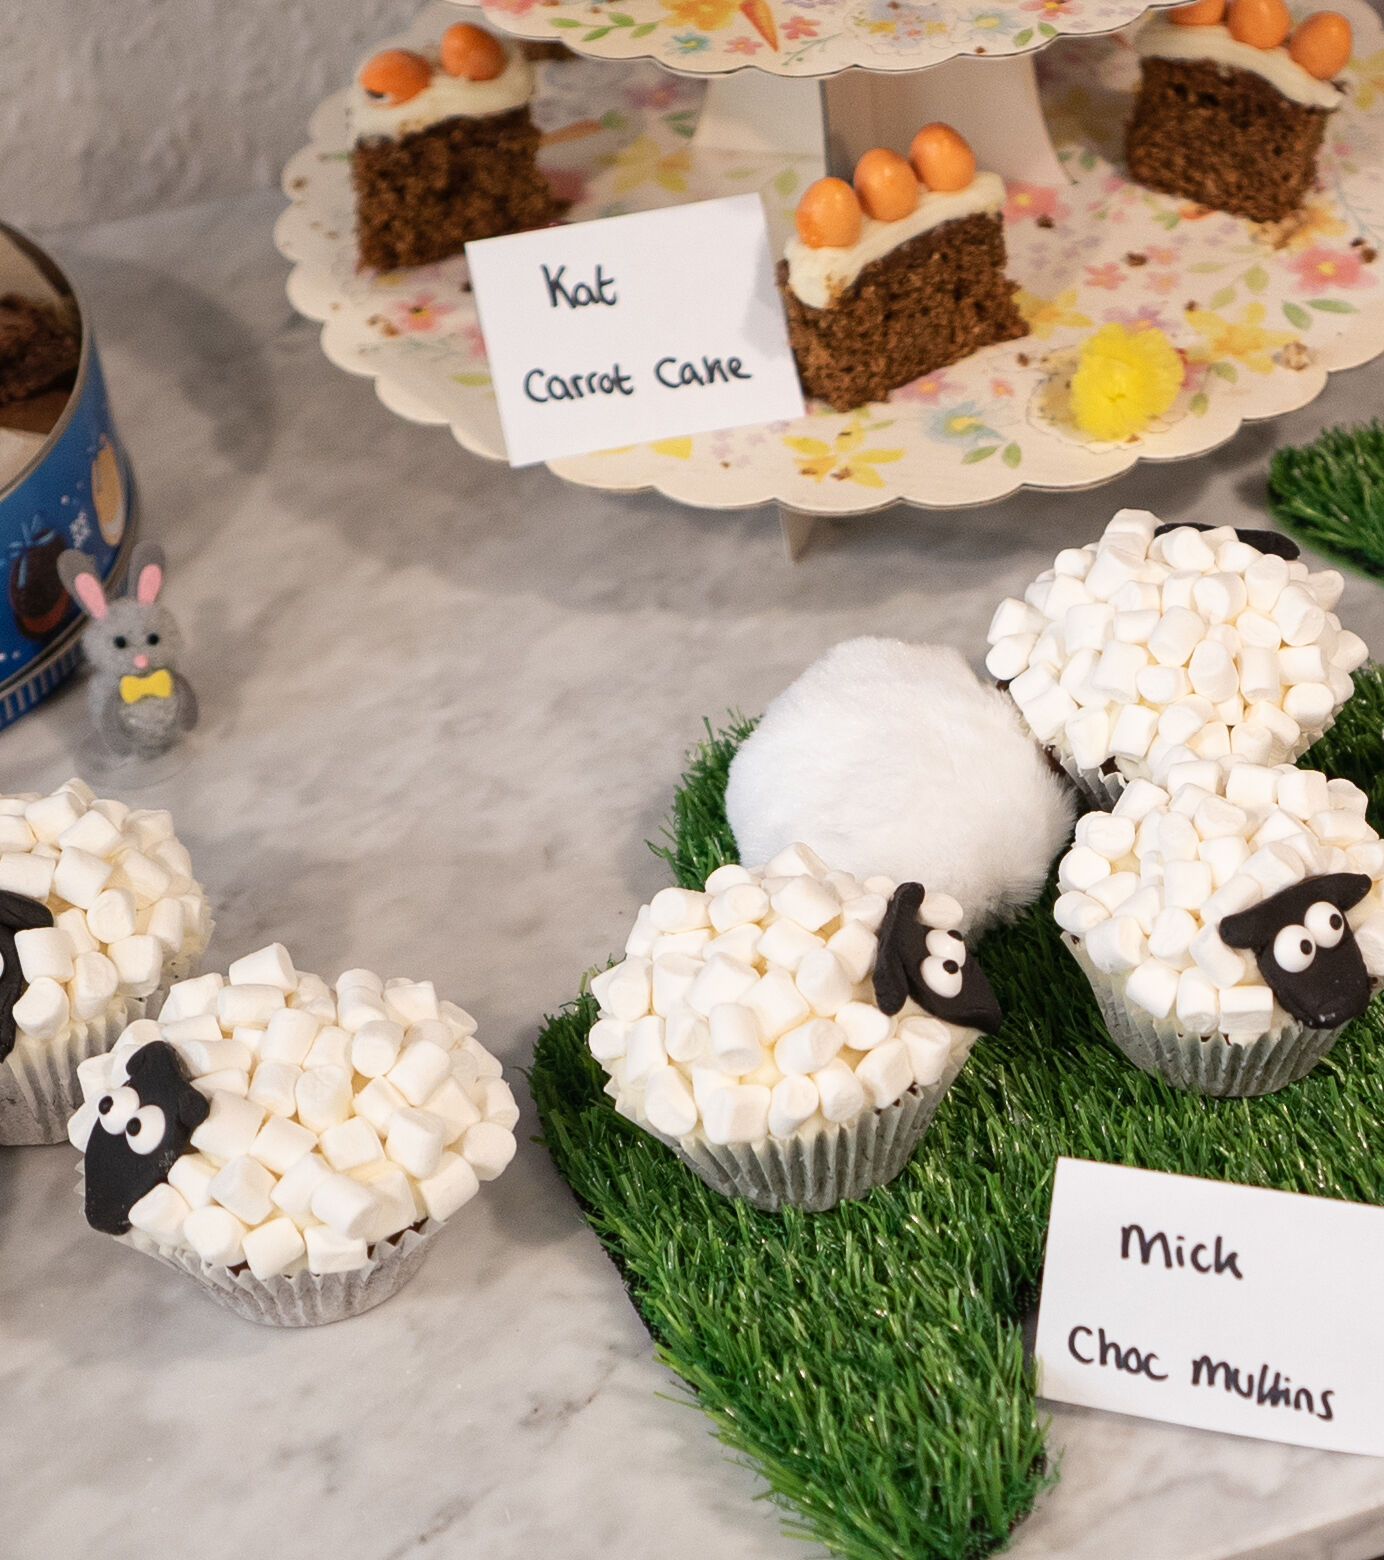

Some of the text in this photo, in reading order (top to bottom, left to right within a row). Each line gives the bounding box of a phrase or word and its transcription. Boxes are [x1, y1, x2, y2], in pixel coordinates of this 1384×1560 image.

[541, 265, 617, 309] Kat
[524, 356, 752, 402] Carrot Cake
[1120, 1223, 1243, 1279] Mick
[1068, 1325, 1168, 1380] Choc
